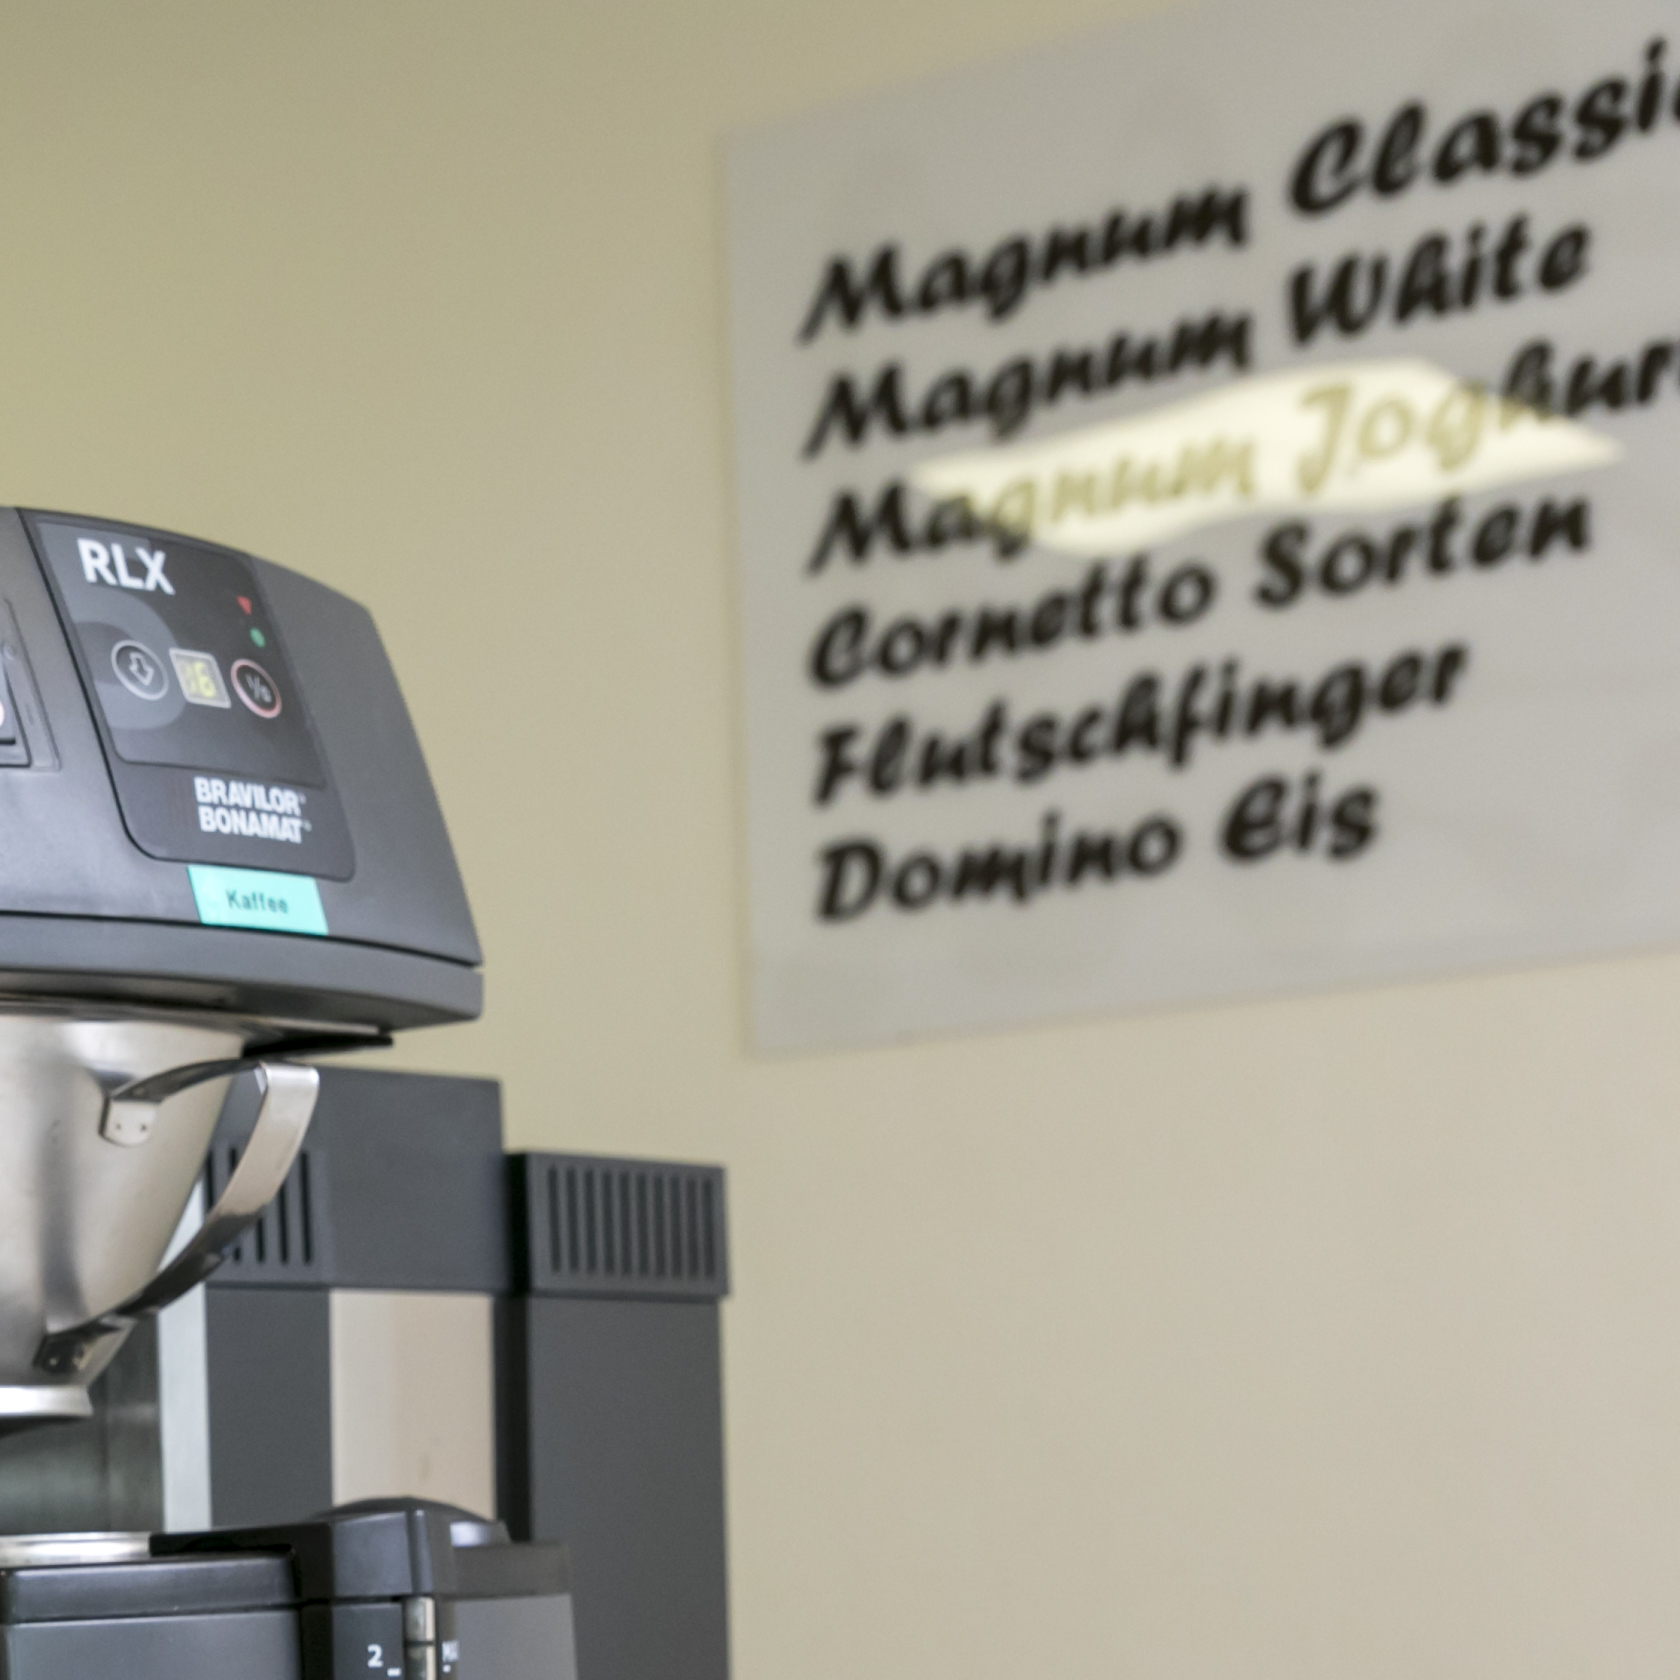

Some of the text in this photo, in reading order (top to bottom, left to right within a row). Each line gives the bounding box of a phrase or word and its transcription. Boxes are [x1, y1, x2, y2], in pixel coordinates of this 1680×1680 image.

[798, 36, 1680, 344] Magnum Classi
[804, 213, 1592, 458] Magnum White
[810, 338, 1680, 575] Magnum Joghur
[76, 537, 176, 595] RLX
[808, 494, 1592, 692] Cornetto Sorten
[812, 642, 1470, 805] Flutschfinger
[225, 890, 290, 915] Kaffee
[816, 774, 1382, 922] Domino Eis
[367, 1643, 385, 1669] 2
